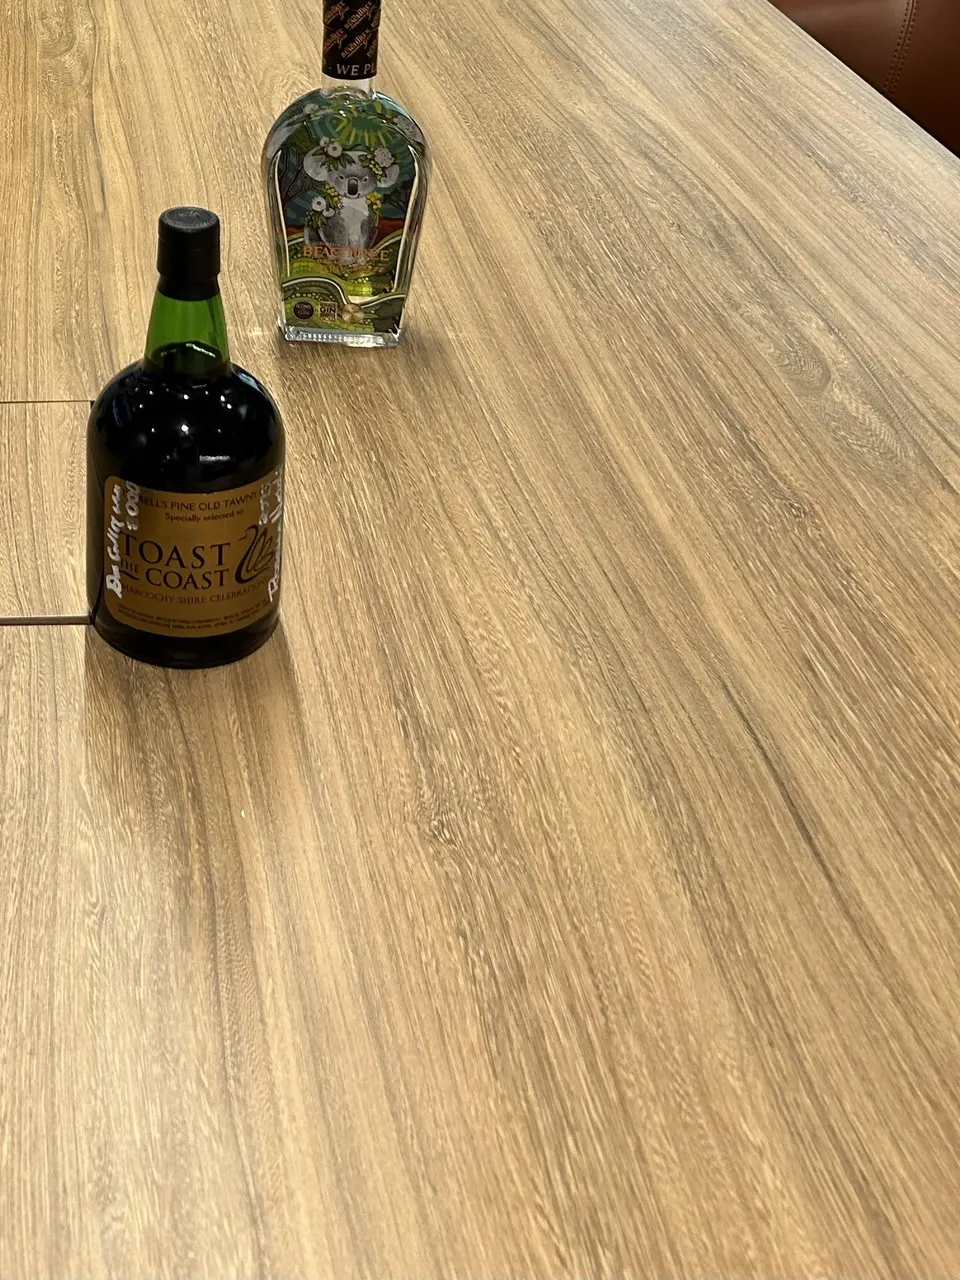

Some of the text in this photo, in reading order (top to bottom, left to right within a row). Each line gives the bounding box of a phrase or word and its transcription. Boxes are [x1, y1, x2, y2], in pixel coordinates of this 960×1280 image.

[336, 63, 360, 76] WE
[319, 306, 337, 314] GIN
[170, 500, 196, 512] FINE
[198, 502, 221, 511] OLD
[223, 491, 258, 508] TAWNY
[164, 512, 201, 523] Specially
[203, 508, 235, 521] selected
[120, 530, 231, 570] TOAST
[145, 568, 230, 590] COAST
